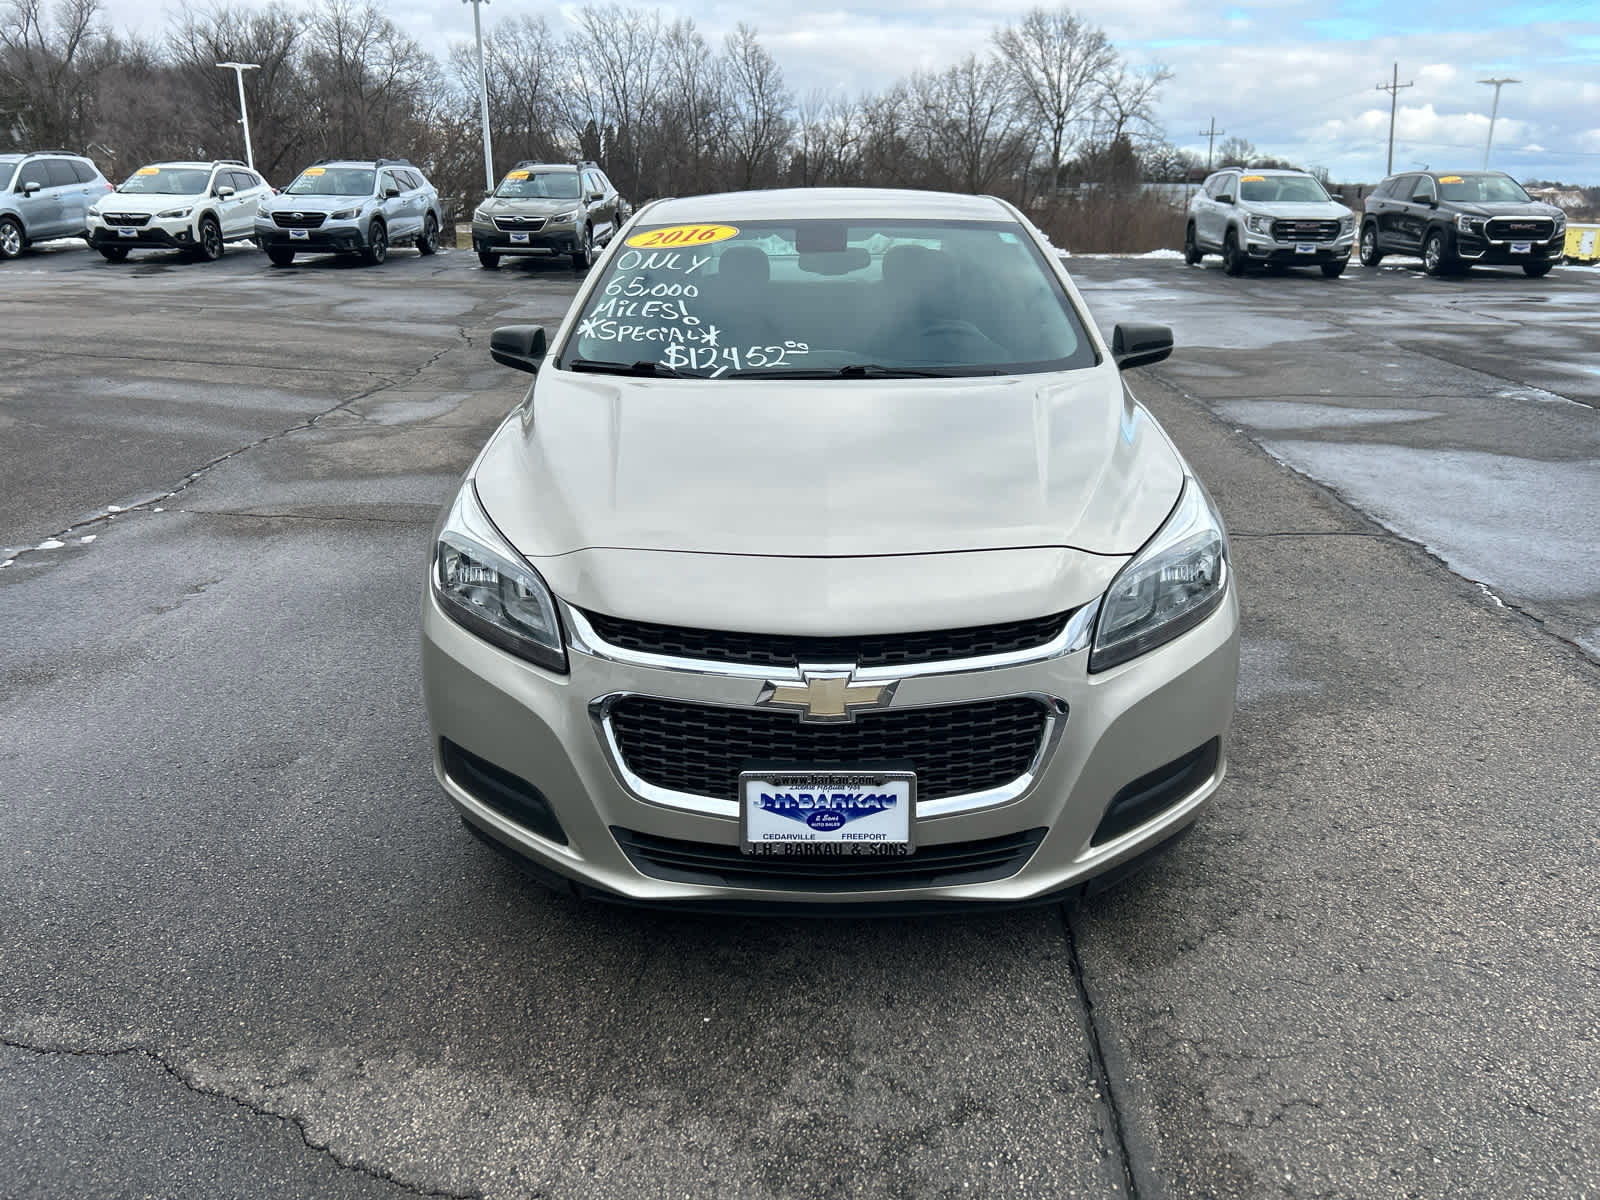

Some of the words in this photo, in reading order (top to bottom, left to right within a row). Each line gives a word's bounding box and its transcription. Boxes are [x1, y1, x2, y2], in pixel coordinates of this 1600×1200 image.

[644, 226, 716, 246] 2016
[616, 250, 711, 274] ONLY
[780, 774, 875, 786] www.barkau.com
[762, 833, 816, 841] CEDARVILLE
[841, 833, 887, 841] FREEPORT
[785, 842, 842, 856] BARKAU
[850, 842, 862, 855] &
[869, 842, 908, 856] SONS
